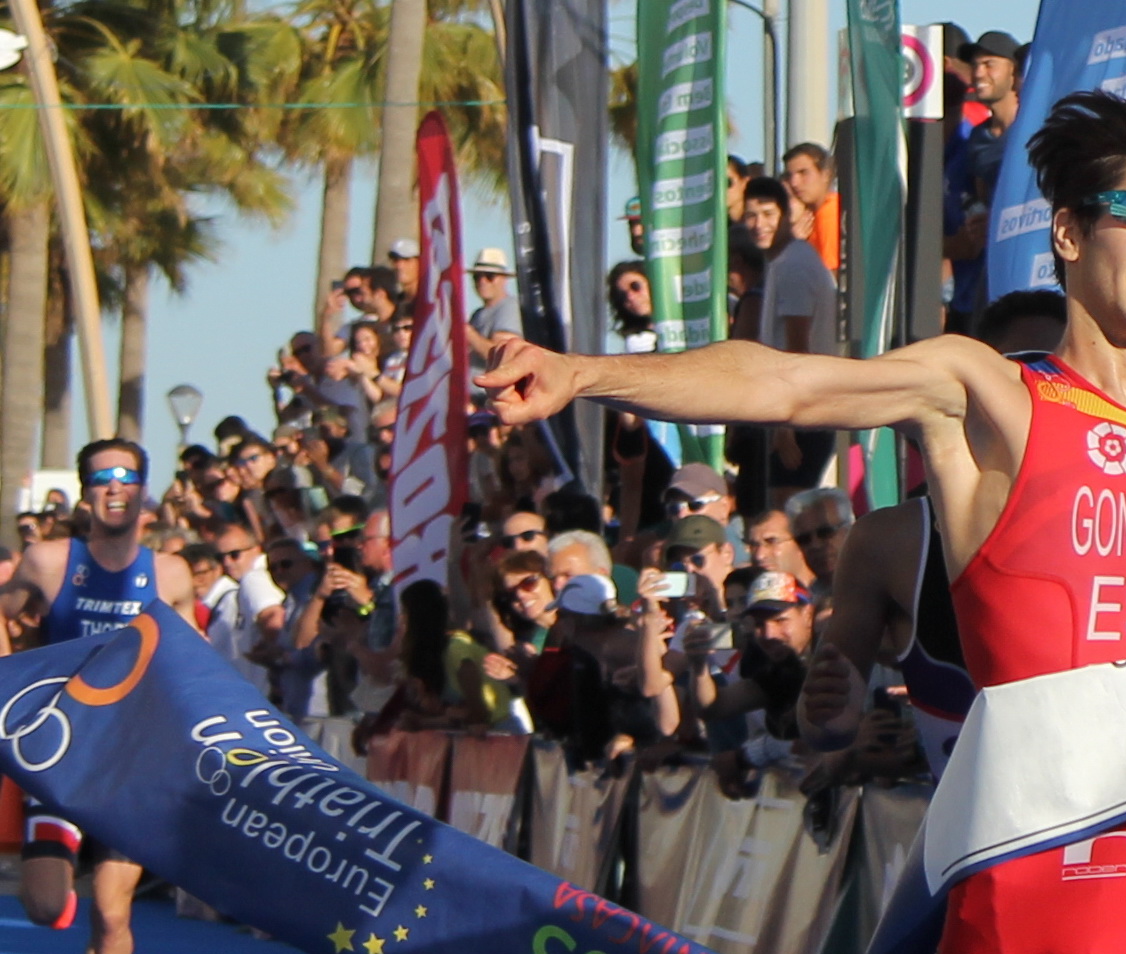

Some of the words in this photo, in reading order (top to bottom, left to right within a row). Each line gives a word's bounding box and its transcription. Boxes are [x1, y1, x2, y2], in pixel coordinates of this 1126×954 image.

[75, 597, 143, 616] TRIMTEX
[190, 714, 422, 872] Triathlon
[221, 798, 395, 918] European
